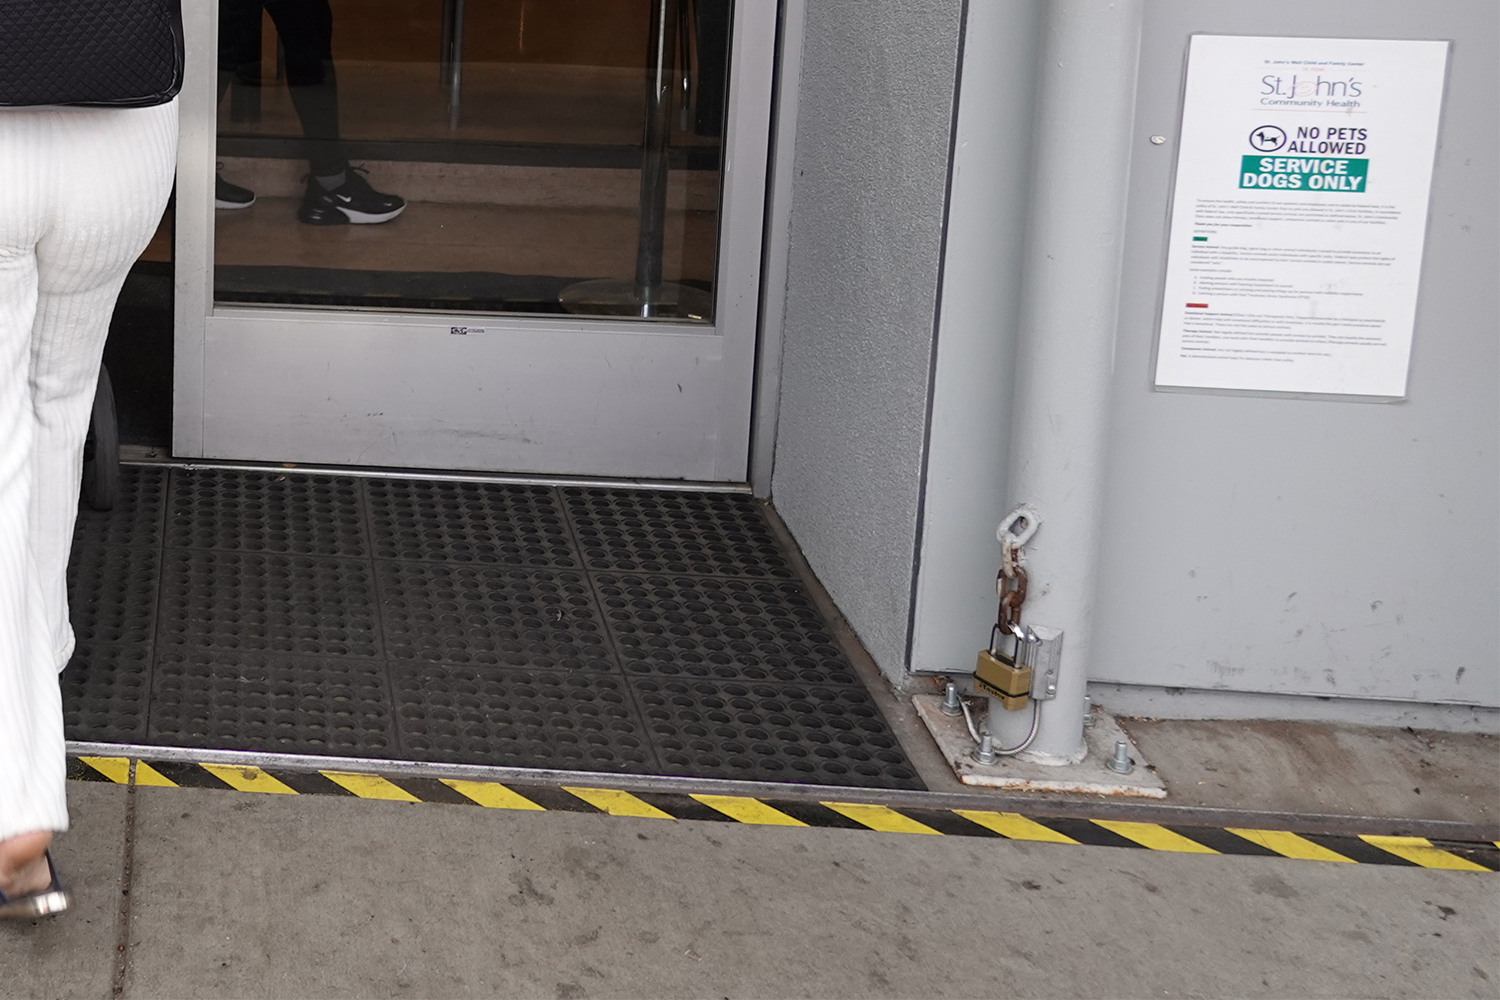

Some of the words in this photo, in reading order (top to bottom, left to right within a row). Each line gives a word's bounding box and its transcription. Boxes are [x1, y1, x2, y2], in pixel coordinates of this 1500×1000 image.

[1260, 98, 1323, 108] Community
[1326, 100, 1361, 108] Health
[1297, 126, 1320, 139] NO
[1327, 127, 1368, 141] PETS
[1287, 141, 1366, 155] ALLOWED
[1258, 157, 1349, 175] SERVICE
[1242, 172, 1302, 189] DOGS
[1308, 174, 1363, 191] ONLY
